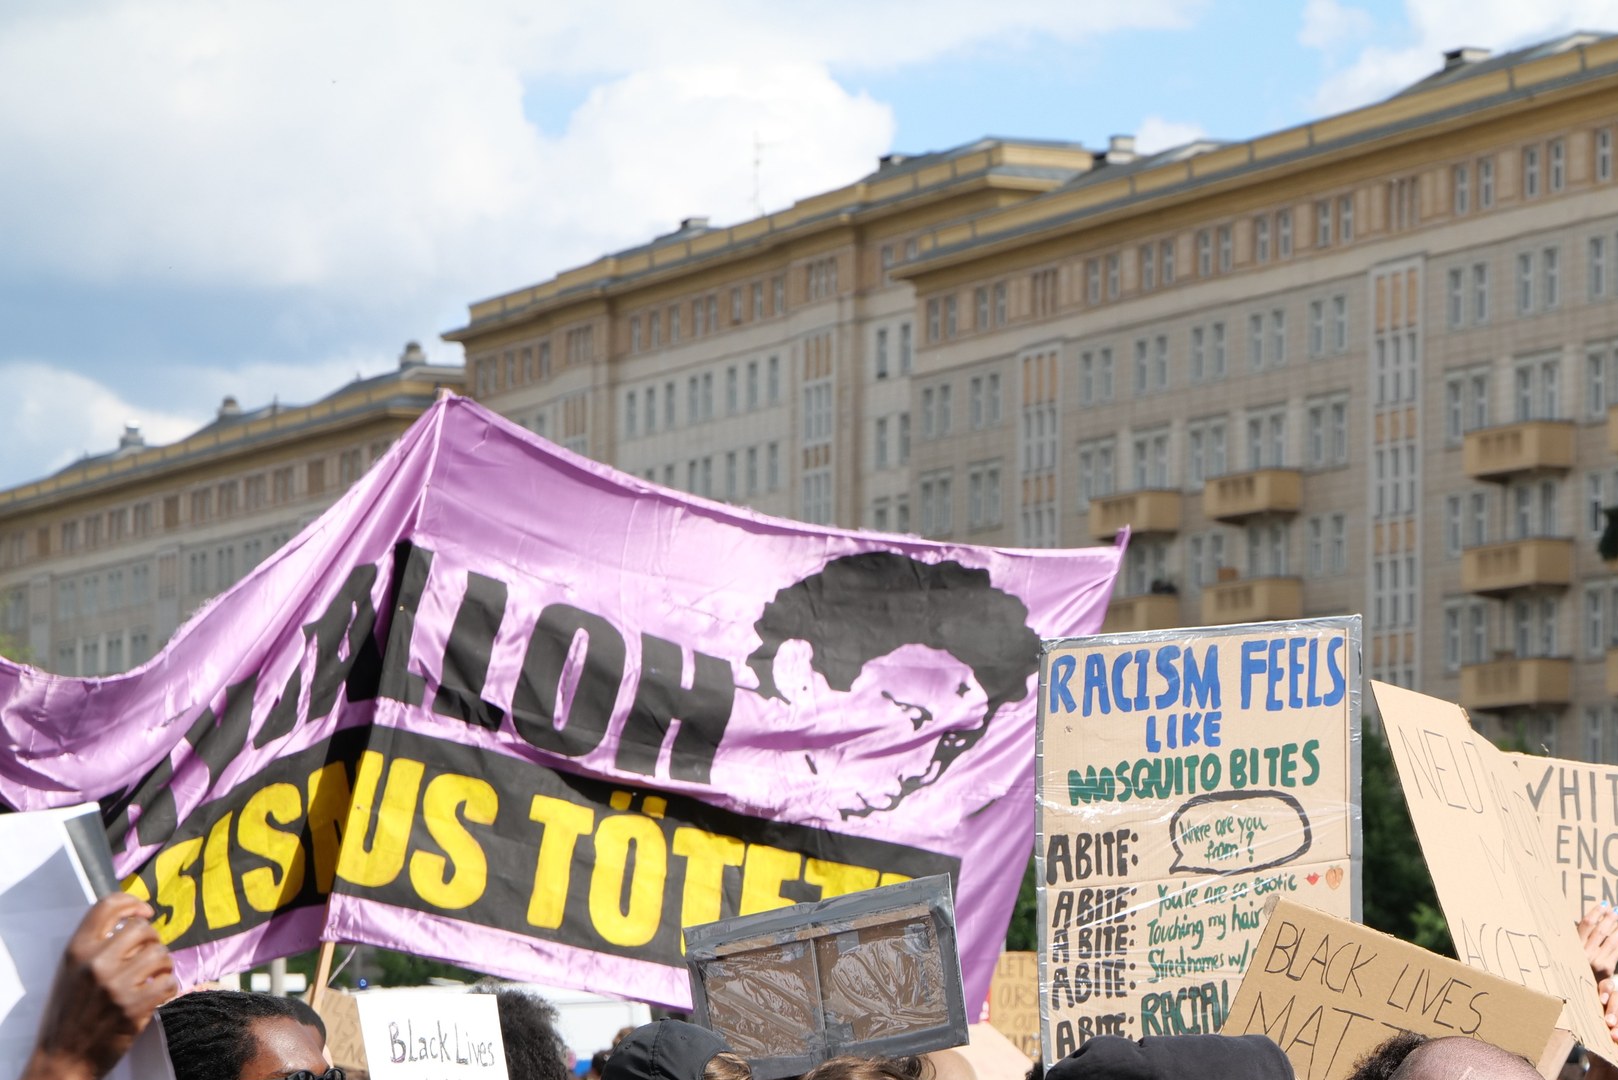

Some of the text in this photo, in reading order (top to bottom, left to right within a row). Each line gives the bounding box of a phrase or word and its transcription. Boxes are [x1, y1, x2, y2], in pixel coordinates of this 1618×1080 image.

[1050, 636, 1346, 717] RACISM FEELS
[1146, 711, 1222, 753] LIKE
[1067, 739, 1319, 806] MOSQUITO BITES
[1215, 816, 1235, 836] are
[1237, 816, 1268, 844] you
[1203, 885, 1228, 904] are
[1147, 914, 1204, 950] Touching
[1208, 914, 1226, 940] my
[1231, 901, 1264, 932] hair
[1265, 921, 1378, 998] BLACK
[1387, 963, 1489, 1034] LIVES
[455, 1022, 495, 1067] Lives
